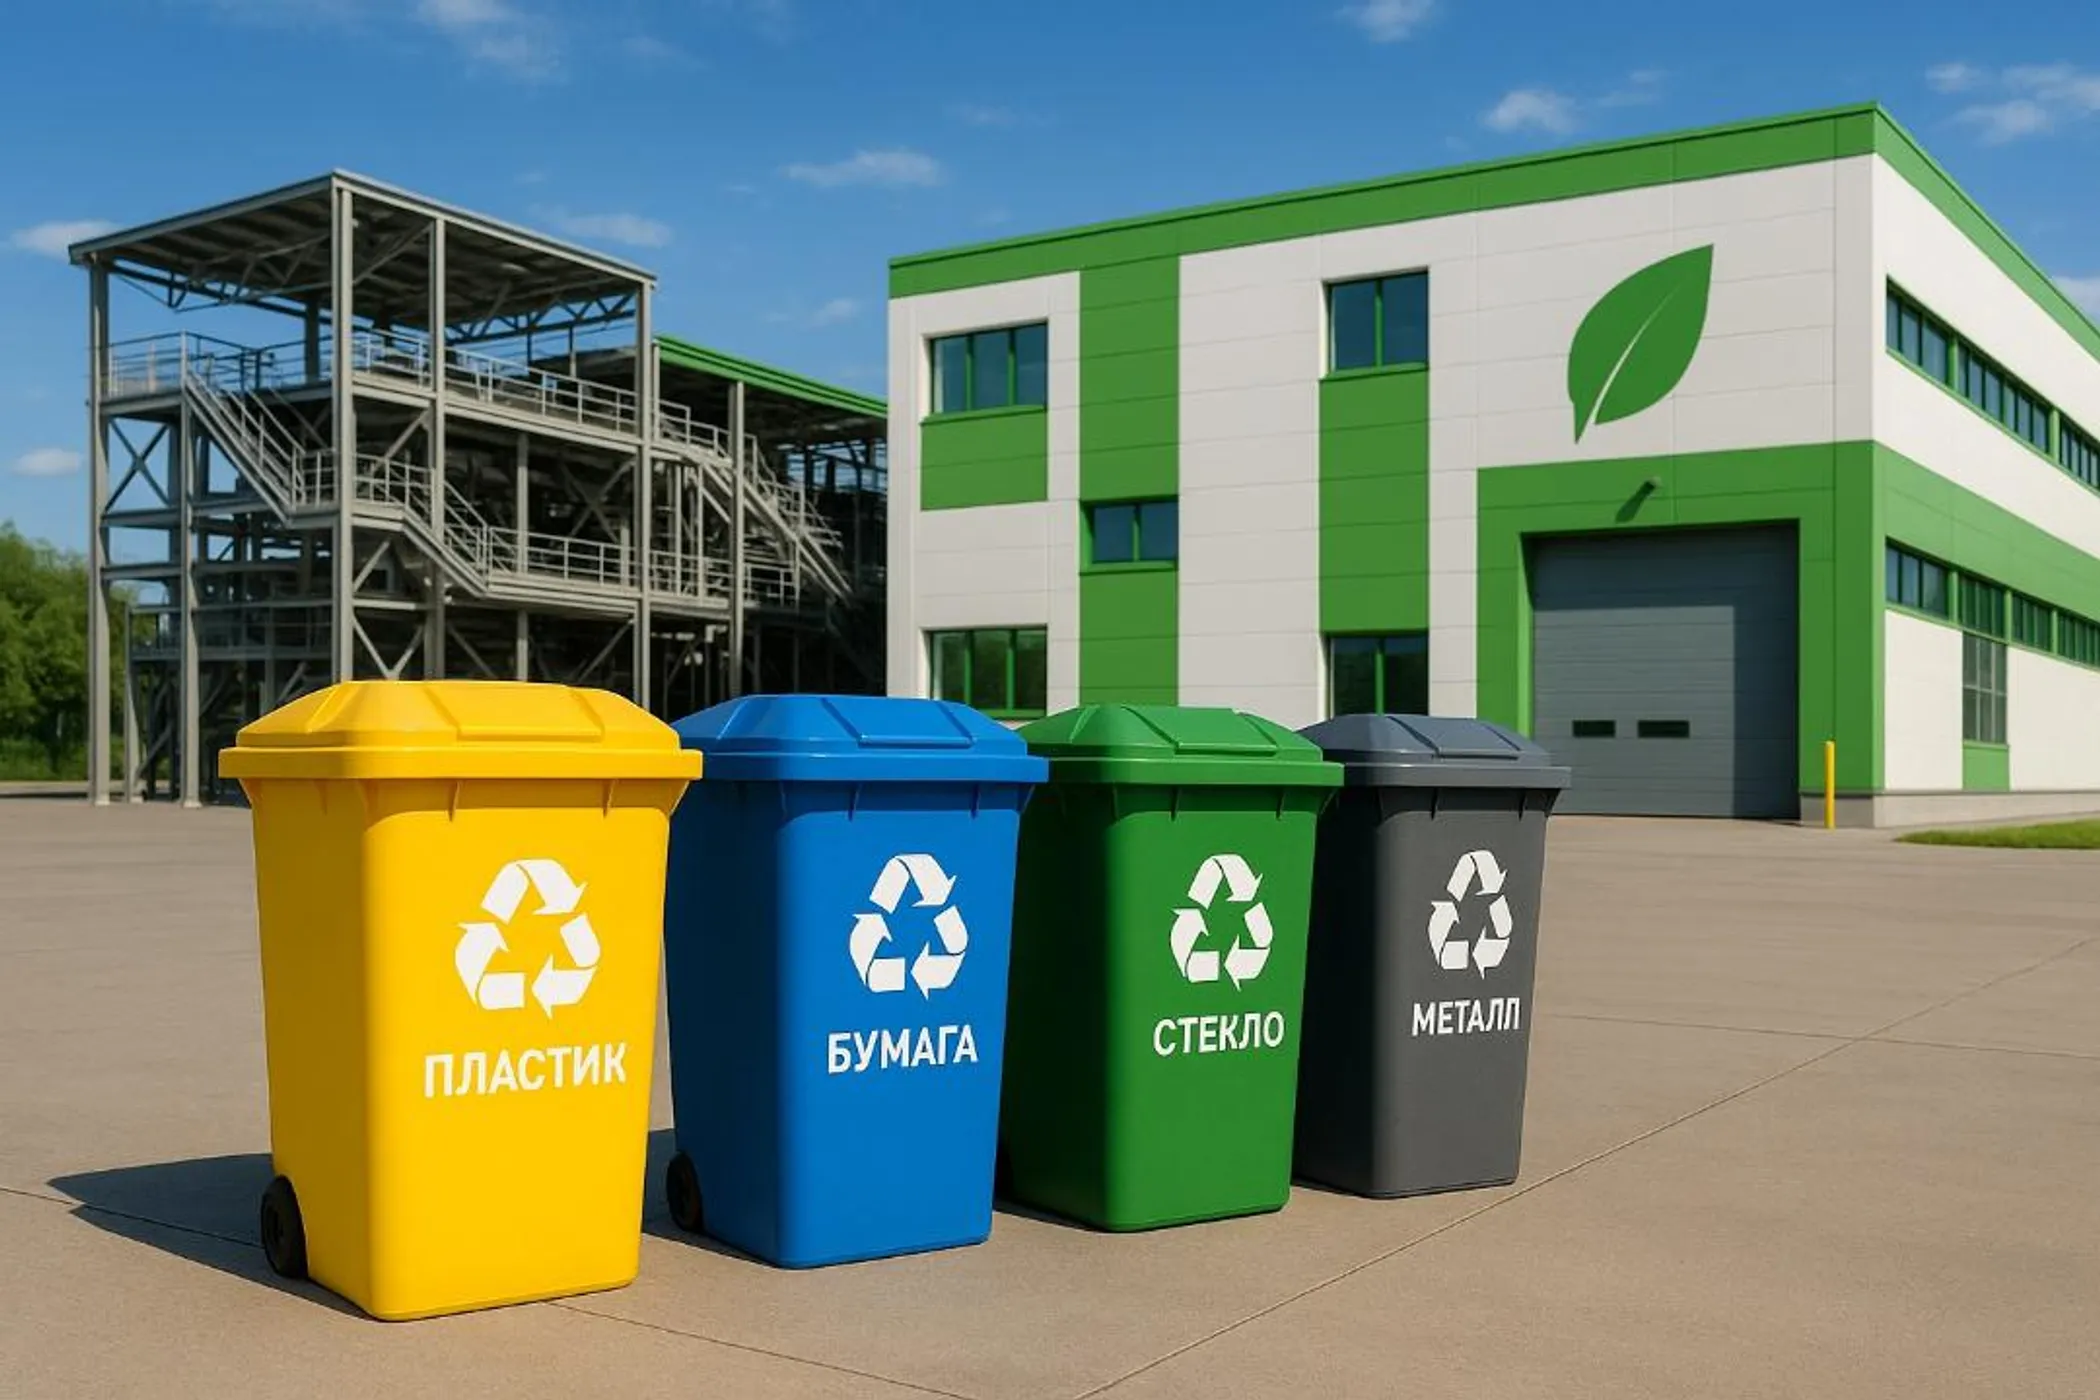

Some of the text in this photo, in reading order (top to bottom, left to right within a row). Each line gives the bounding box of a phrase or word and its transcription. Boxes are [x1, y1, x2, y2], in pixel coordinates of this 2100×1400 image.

[1153, 1011, 1284, 1056] СТЕКЛО
[1412, 997, 1520, 1036] МЕТАЛЛ
[425, 1042, 626, 1098] ПЛАСТИК
[828, 1024, 978, 1074] БУМАГА
